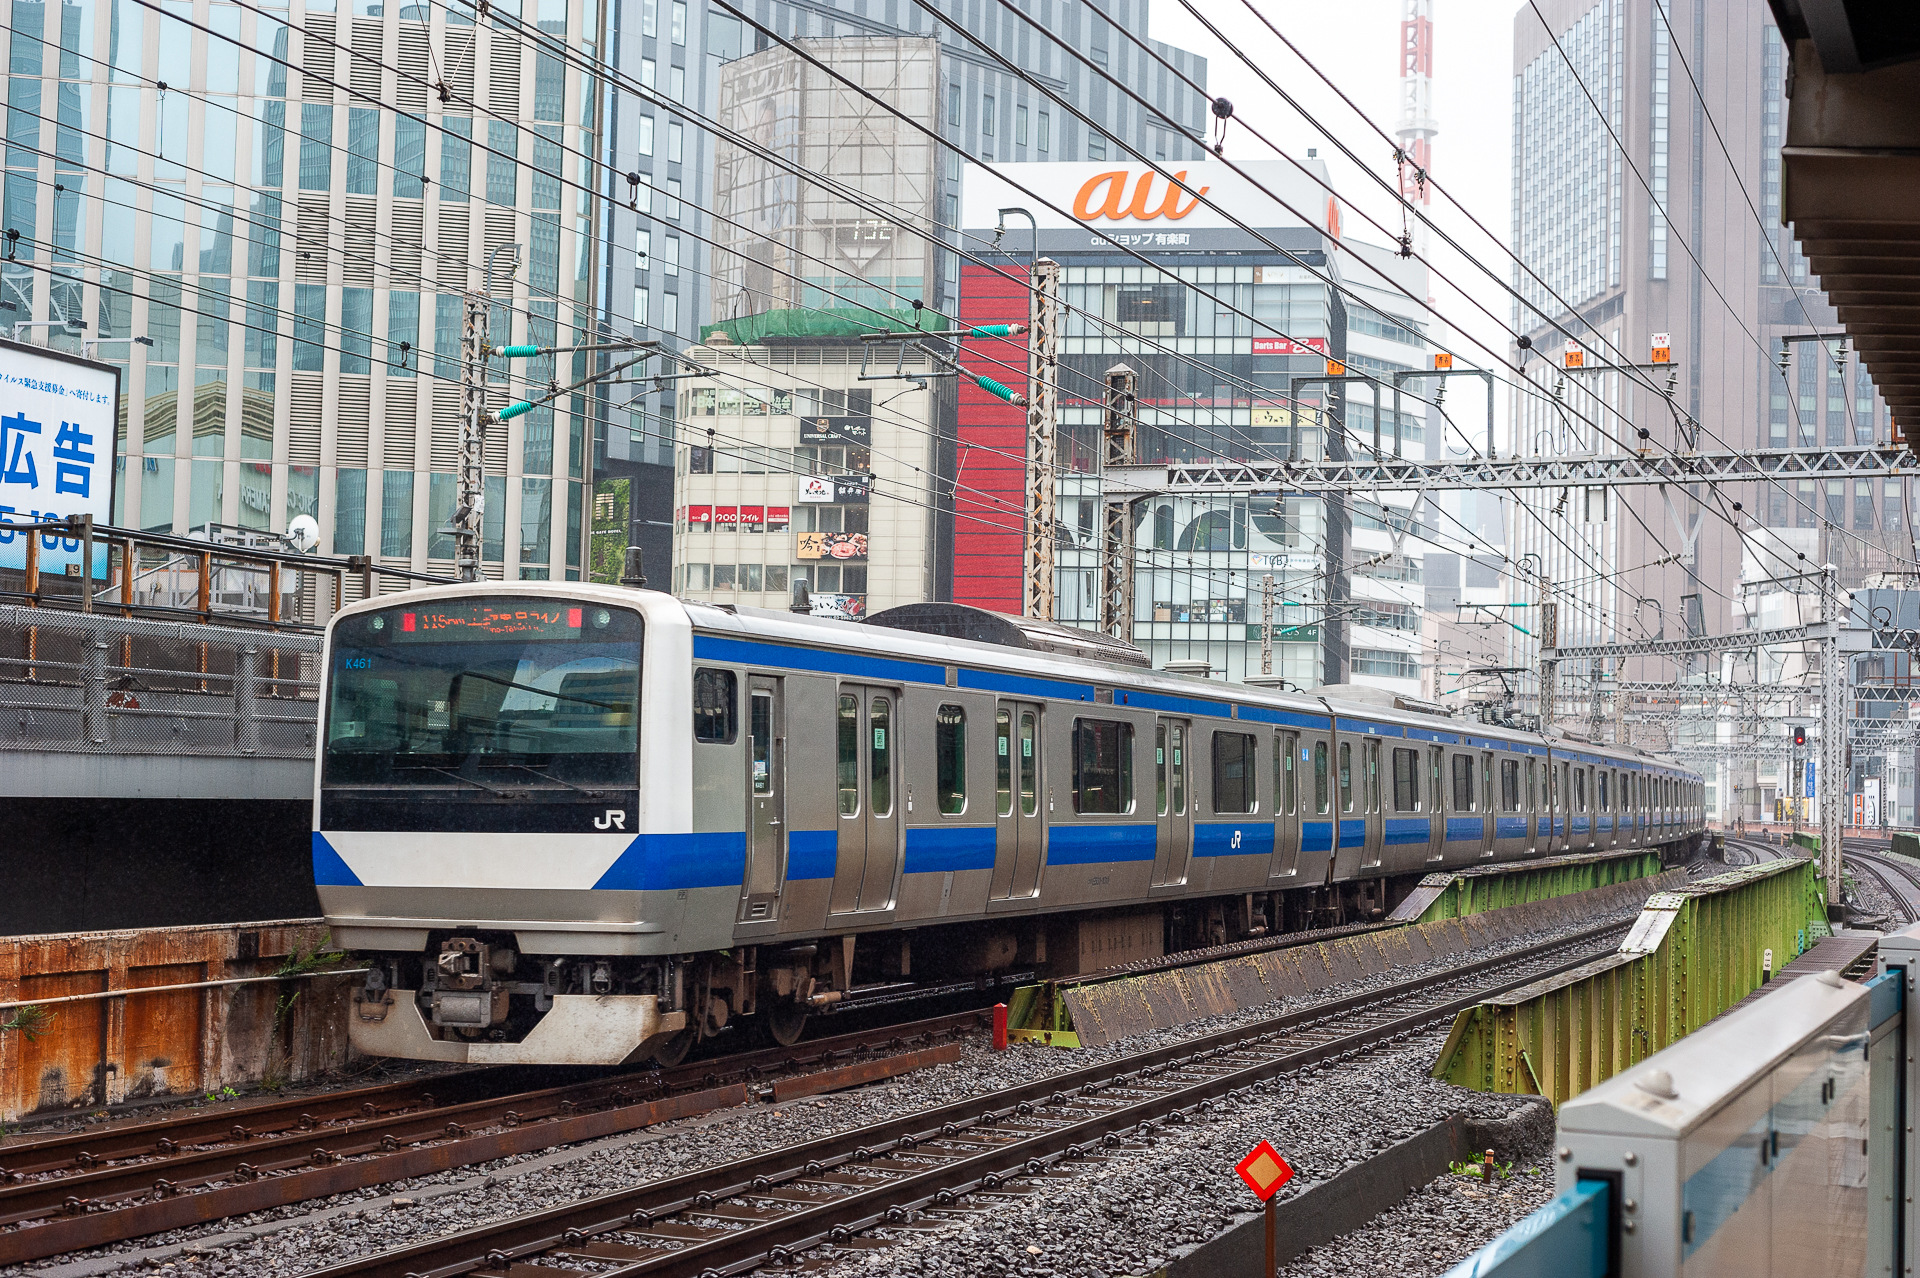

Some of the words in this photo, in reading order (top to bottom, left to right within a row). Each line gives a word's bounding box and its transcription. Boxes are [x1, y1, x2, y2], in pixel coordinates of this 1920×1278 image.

[1073, 170, 1210, 221] au
[1254, 341, 1273, 350] Darts
[1274, 341, 1287, 350] Bar
[0, 411, 95, 499] 広告
[345, 658, 372, 669] K461
[594, 809, 626, 830] JR
[1231, 830, 1242, 849] JR
